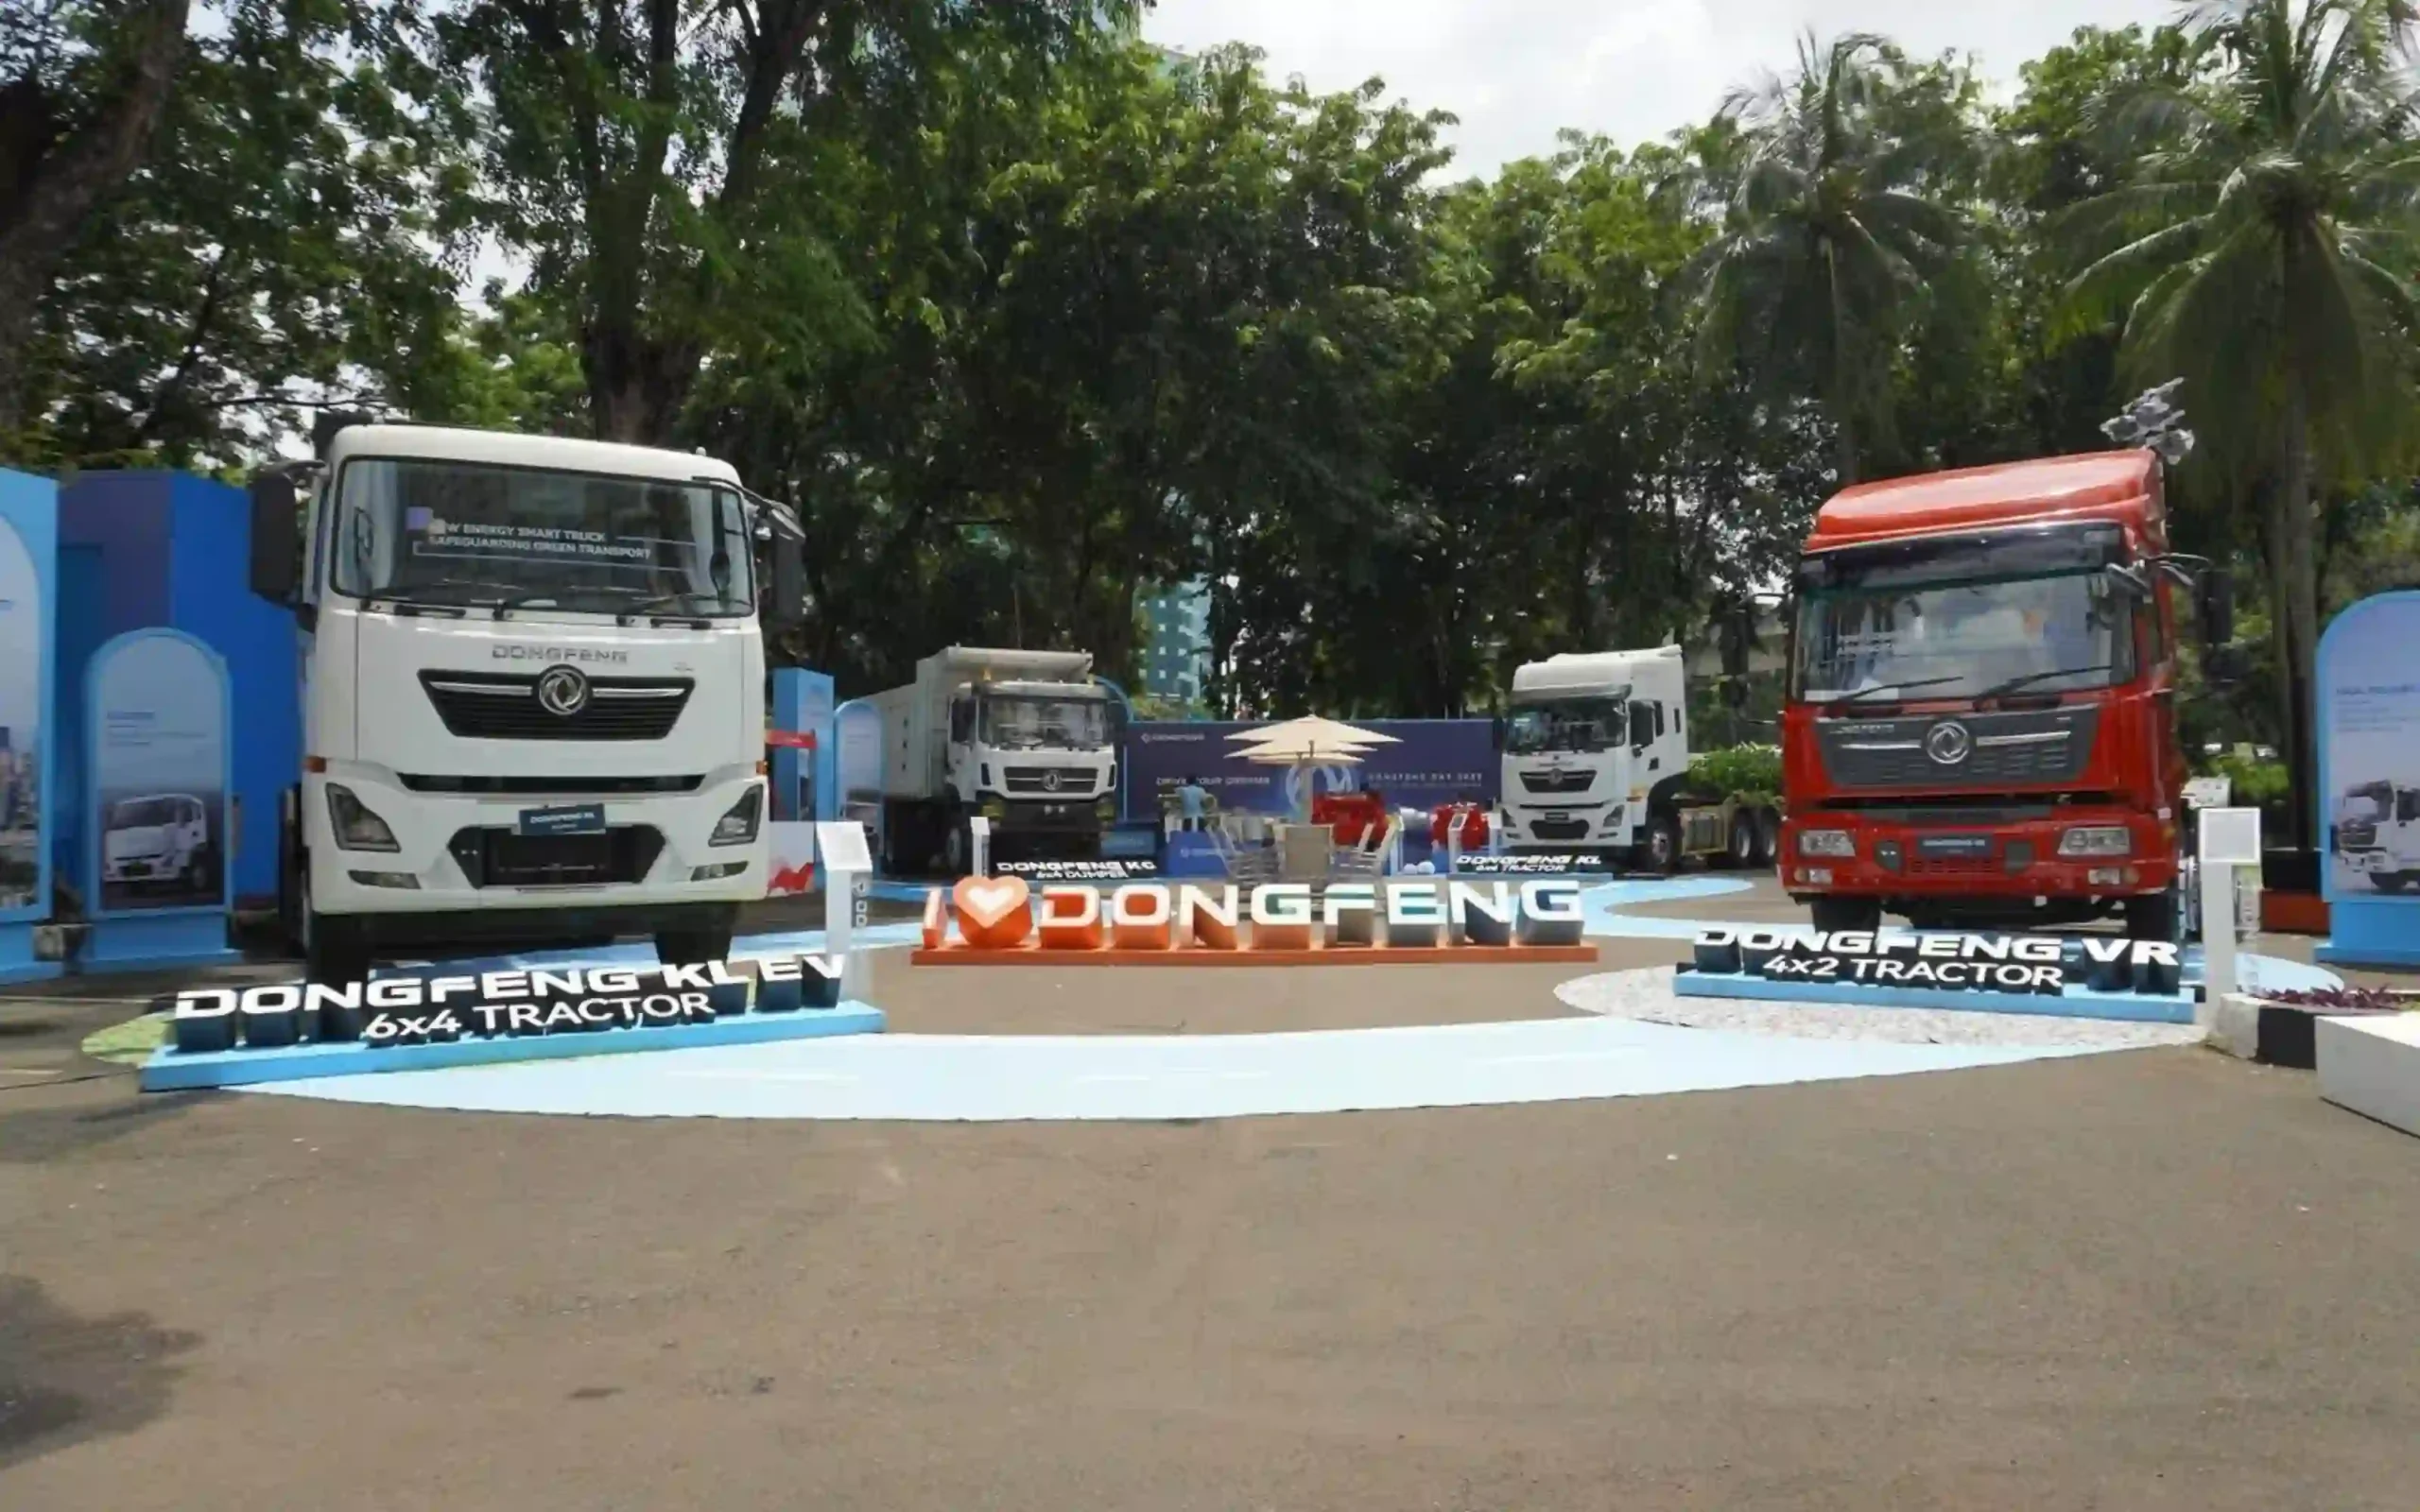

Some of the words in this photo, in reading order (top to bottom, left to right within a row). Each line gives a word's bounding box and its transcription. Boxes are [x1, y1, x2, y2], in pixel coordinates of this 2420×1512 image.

[464, 523, 513, 535] ENERGY
[516, 525, 561, 540] SMART
[562, 529, 606, 542] TRUCK
[532, 541, 576, 554] GREEN
[578, 544, 651, 559] TRANSPORT
[492, 644, 628, 662] DONGFENG
[996, 861, 1122, 871] DONGFENG
[1455, 854, 1573, 865] DONGFENG
[1574, 854, 1602, 865] KL
[1502, 864, 1565, 872] TRACTOR
[1042, 880, 1584, 926] DONGFENG
[1694, 929, 2063, 960] DONGFENG
[2081, 937, 2179, 966] VR
[1762, 954, 1840, 976] 4x2
[1849, 957, 2064, 988] TRACTOR
[175, 970, 640, 1020] DONGFENG
[661, 959, 752, 988] KL
[757, 954, 846, 980] EV
[365, 1009, 463, 1039] 6x4
[472, 993, 717, 1029] TRACTOR
